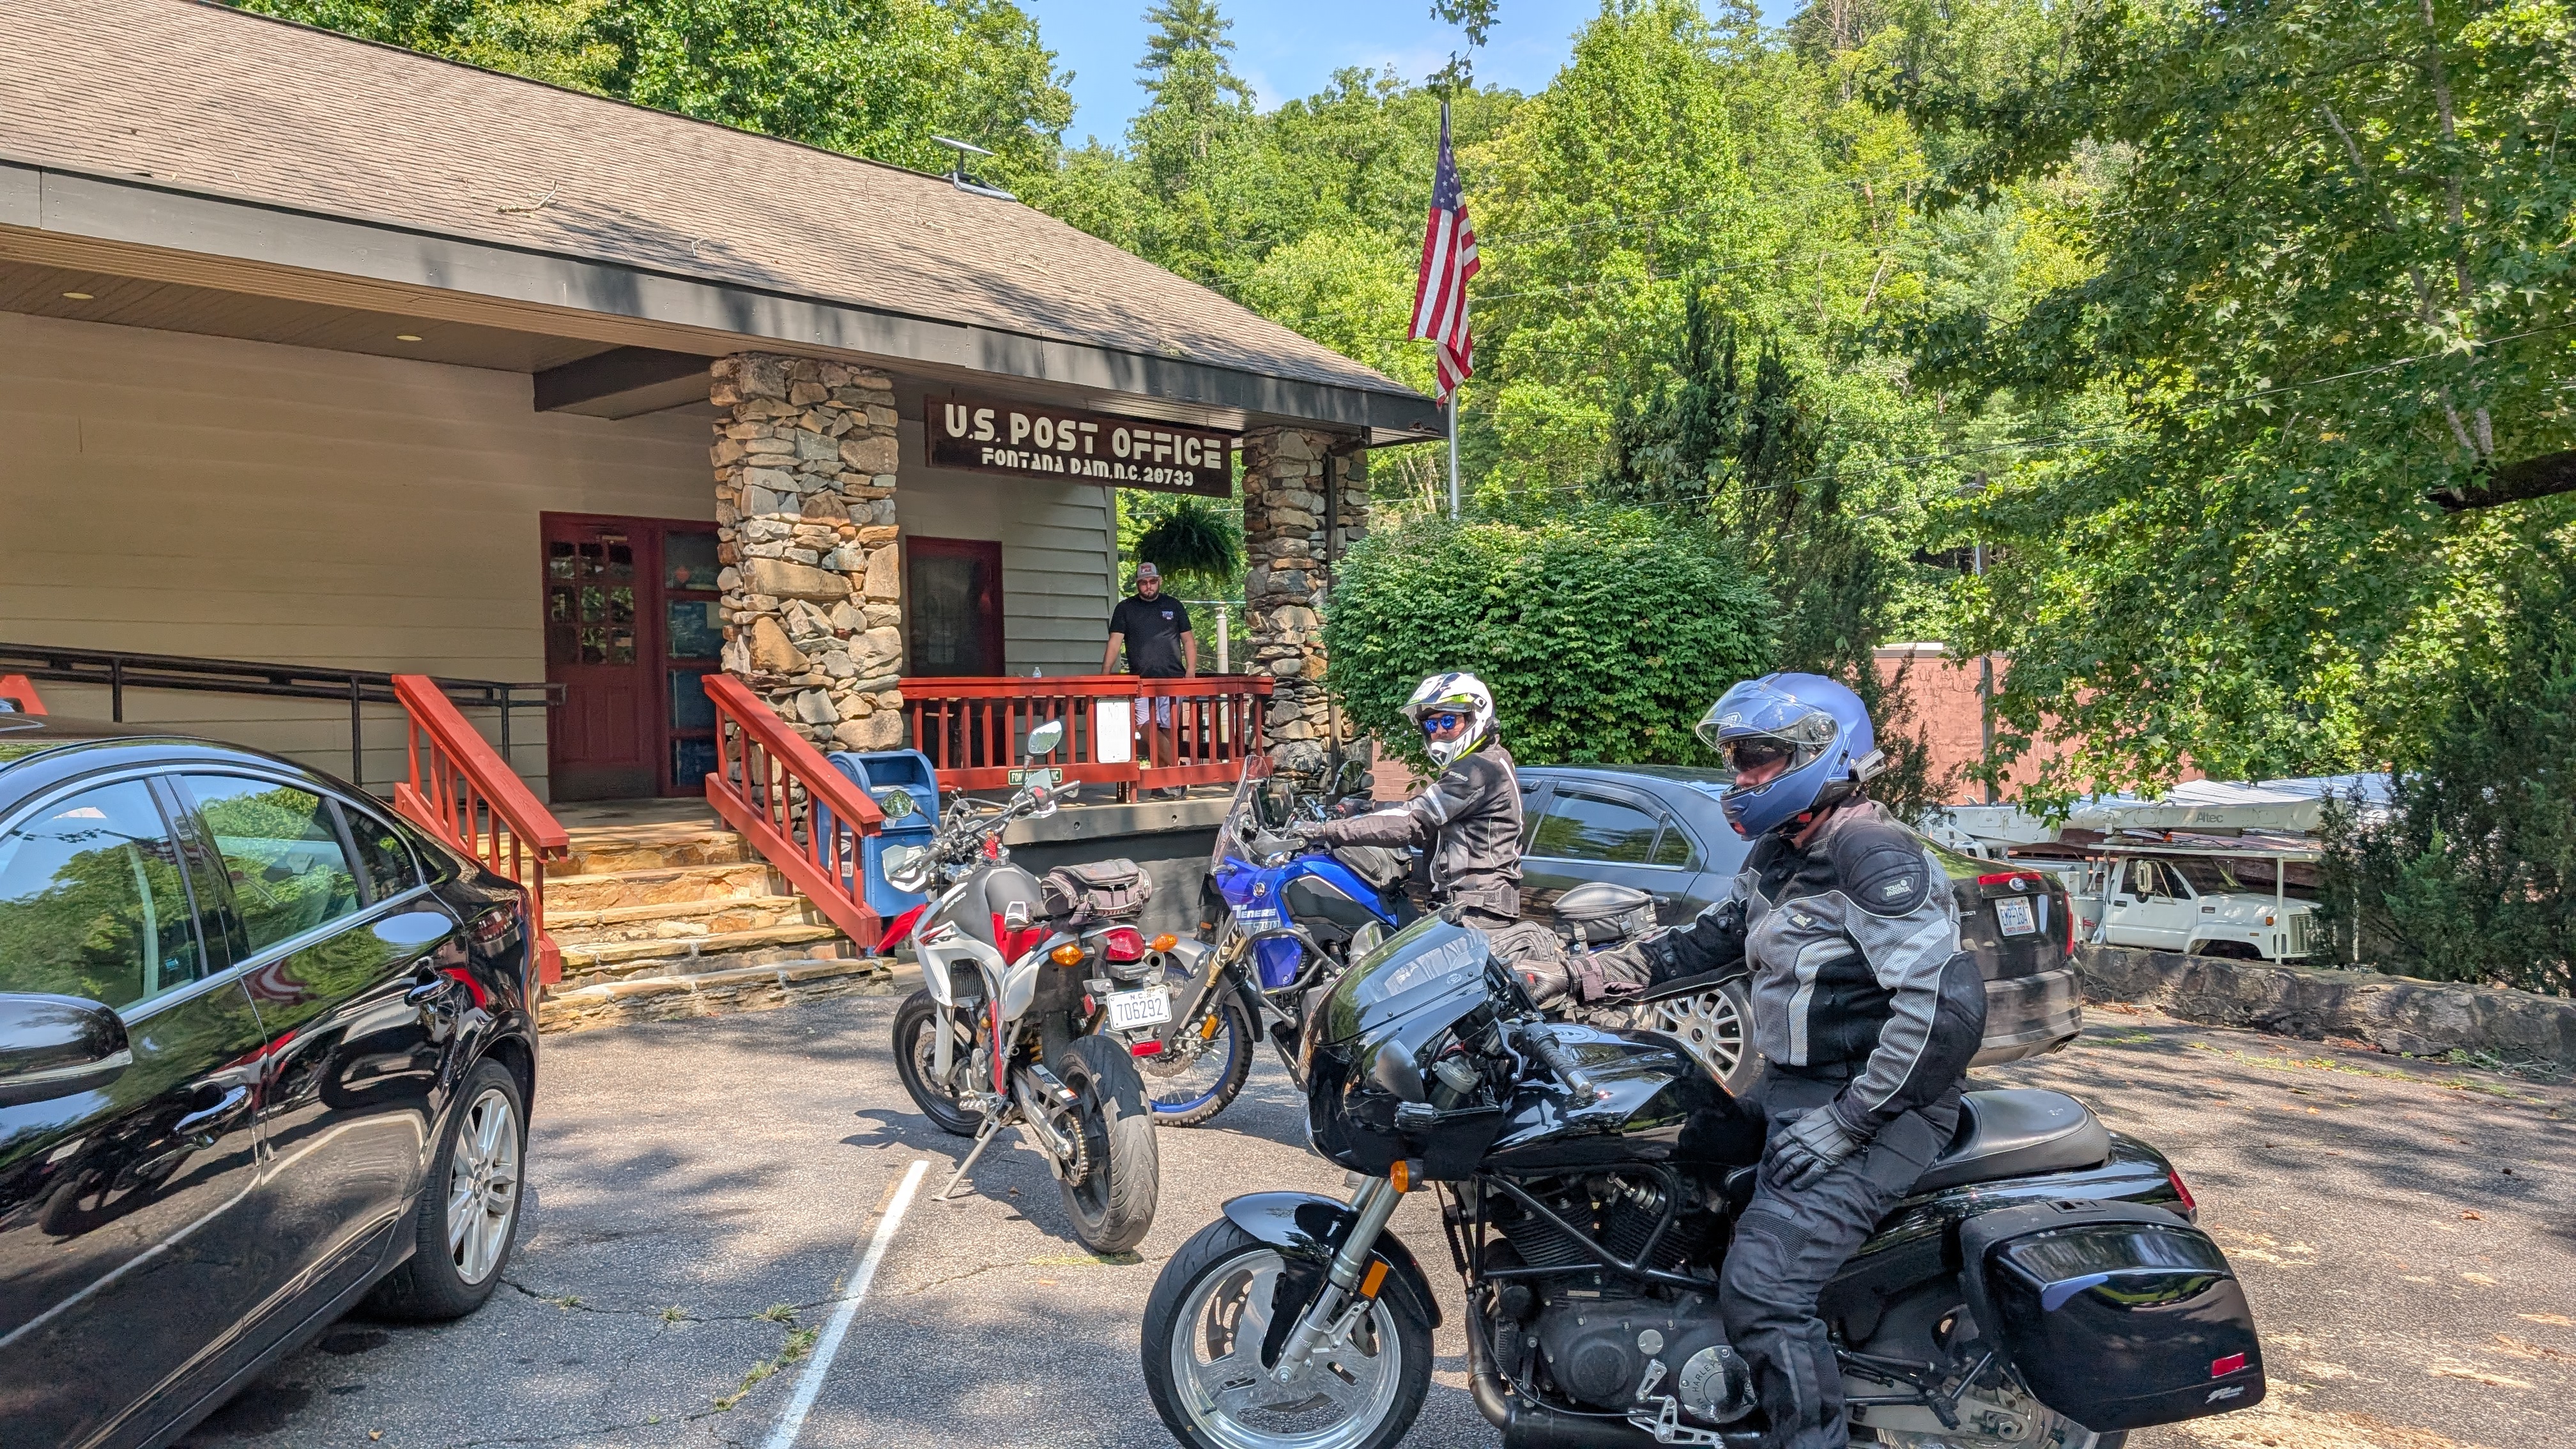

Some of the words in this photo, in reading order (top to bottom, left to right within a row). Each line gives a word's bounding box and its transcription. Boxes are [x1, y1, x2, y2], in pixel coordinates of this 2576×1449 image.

[944, 403, 1001, 443] U.S.
[1009, 412, 1098, 454] POST
[1112, 427, 1222, 470] OFFICE
[982, 447, 1064, 473] FONTANA
[1107, 705, 1120, 720] NO
[2196, 812, 2223, 823] Altec
[1883, 884, 1901, 892] TOUR
[1886, 886, 1912, 897] MASTER
[2000, 906, 2031, 926] EMP-1547
[1116, 998, 1163, 1022] 706292
